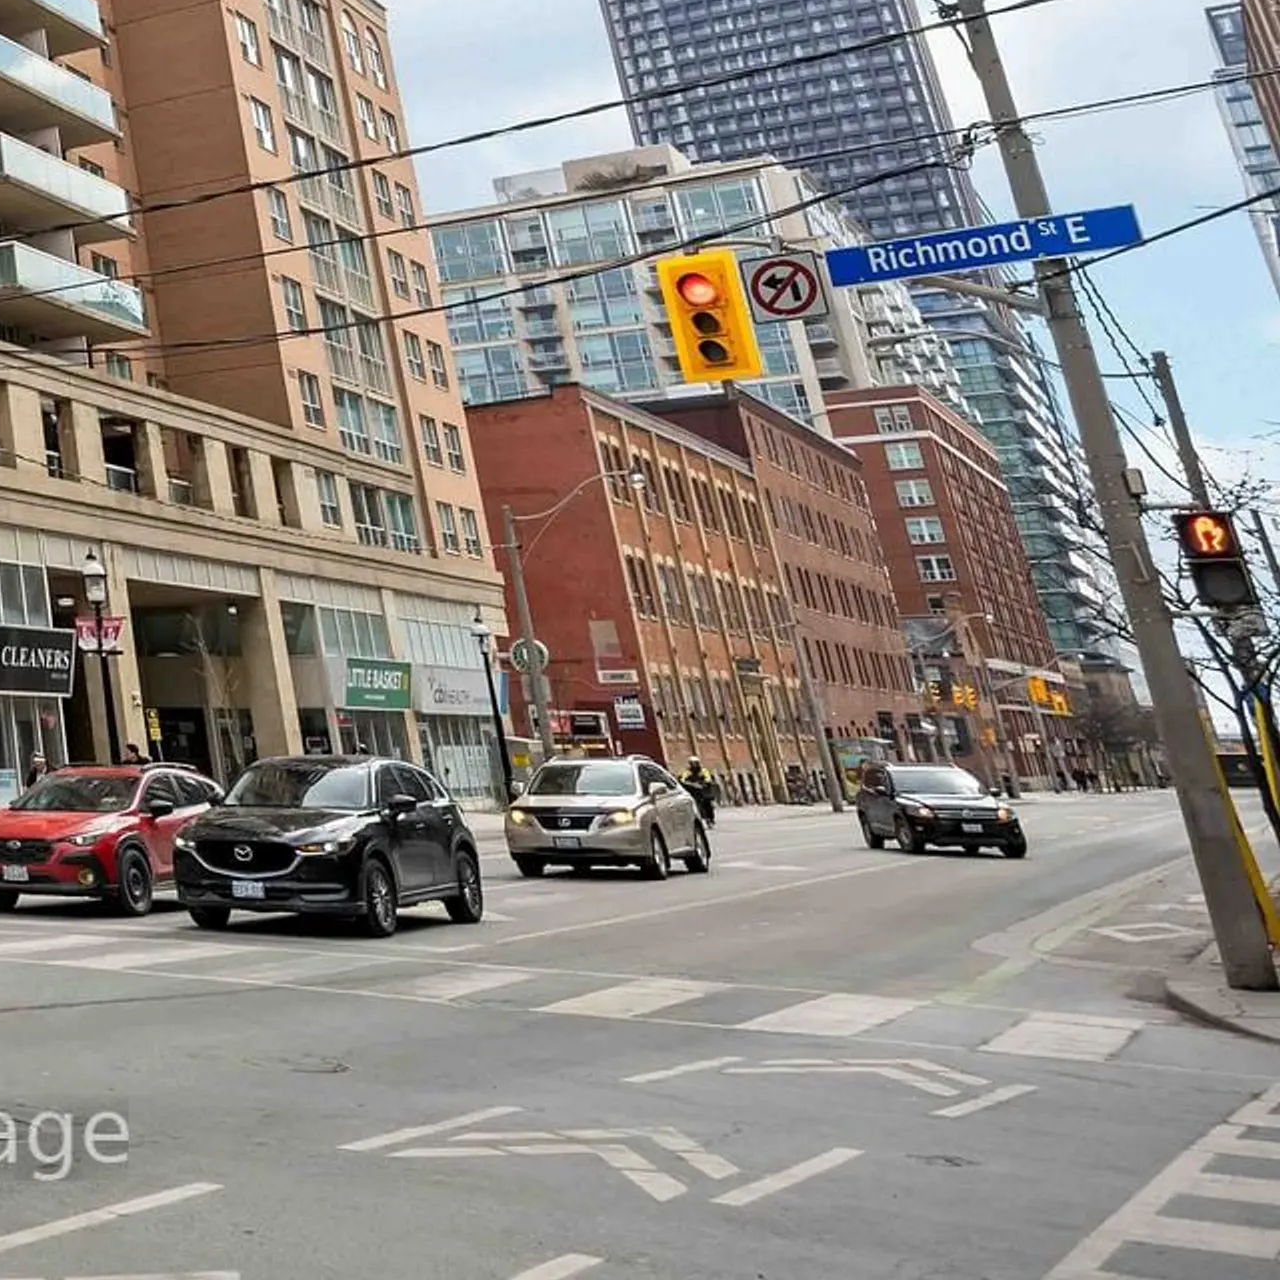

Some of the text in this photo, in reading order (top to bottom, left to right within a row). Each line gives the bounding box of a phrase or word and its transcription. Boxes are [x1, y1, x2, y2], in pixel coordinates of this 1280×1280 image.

[866, 216, 1092, 274] Richmond St E
[1, 645, 71, 671] CLEANERS
